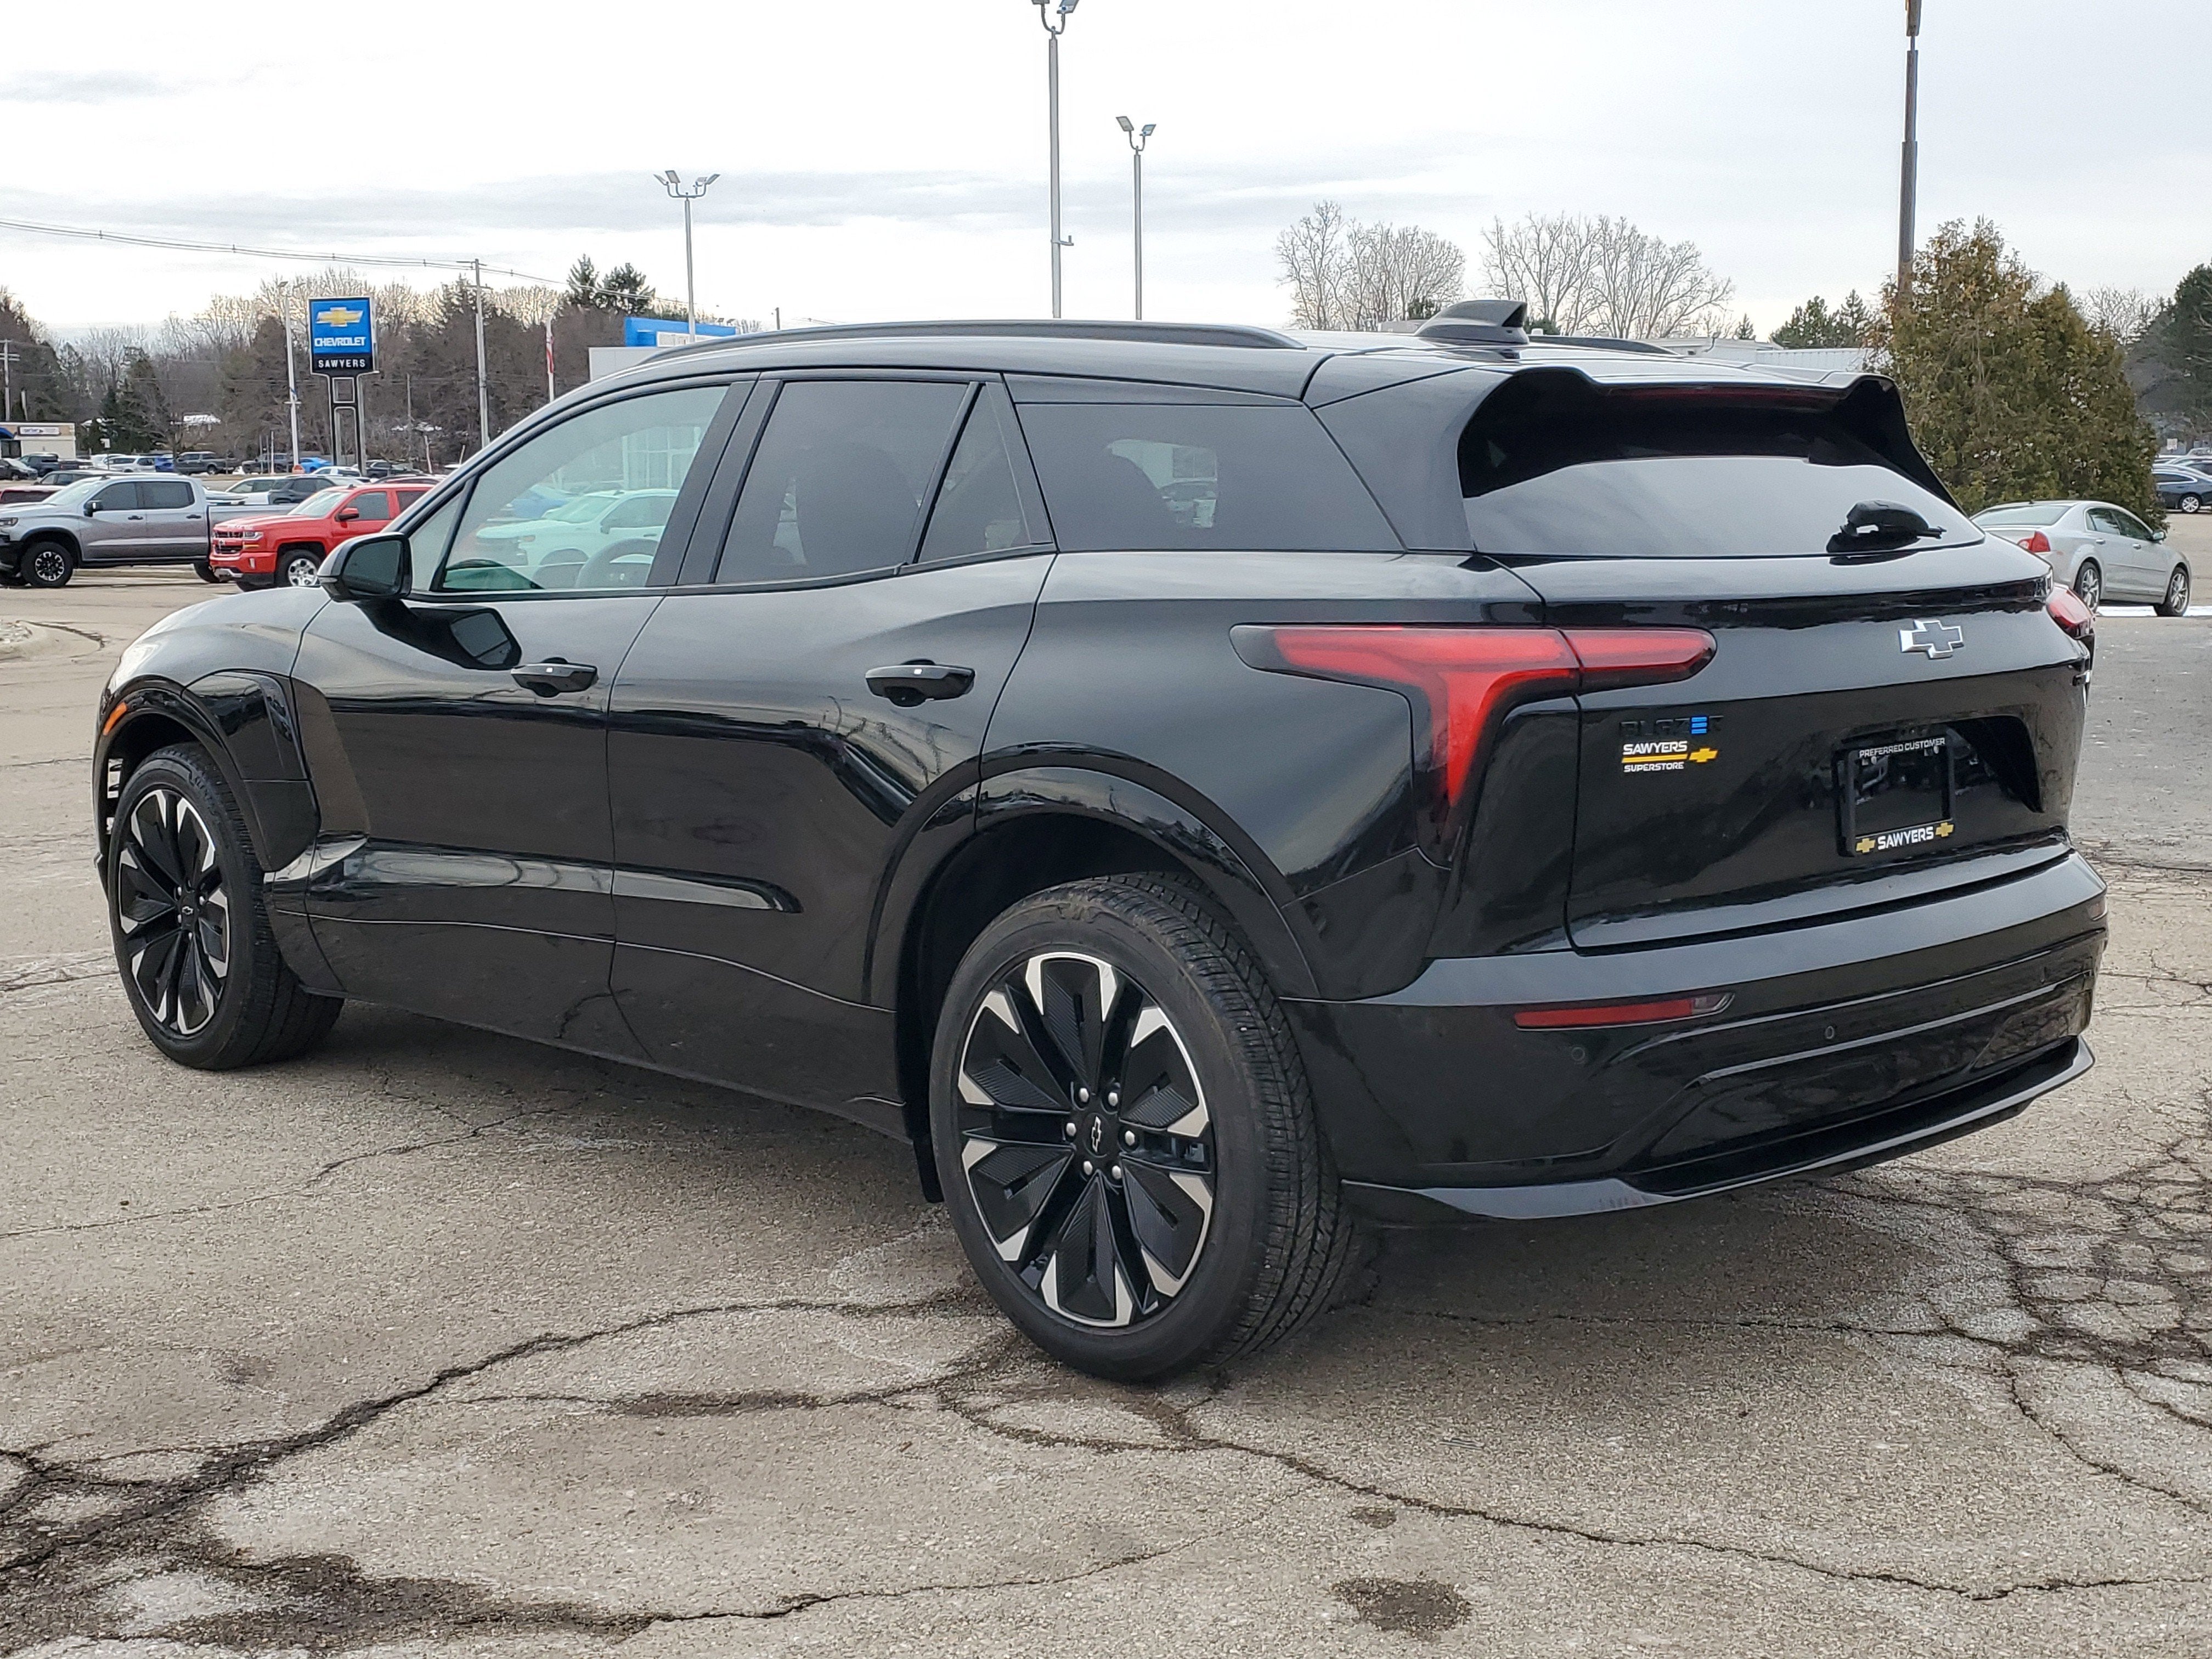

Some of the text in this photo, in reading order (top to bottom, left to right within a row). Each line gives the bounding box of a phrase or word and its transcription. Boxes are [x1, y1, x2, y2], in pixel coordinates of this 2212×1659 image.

[314, 336, 366, 347] CHEVROLET
[318, 359, 365, 368] SAWYERS
[1622, 741, 1688, 755] SAWYERS
[1859, 737, 1945, 758] PREFERRED CUSTOMER
[1623, 761, 1685, 773] SUPERSTORE
[1877, 826, 1934, 850] SAWYERS
